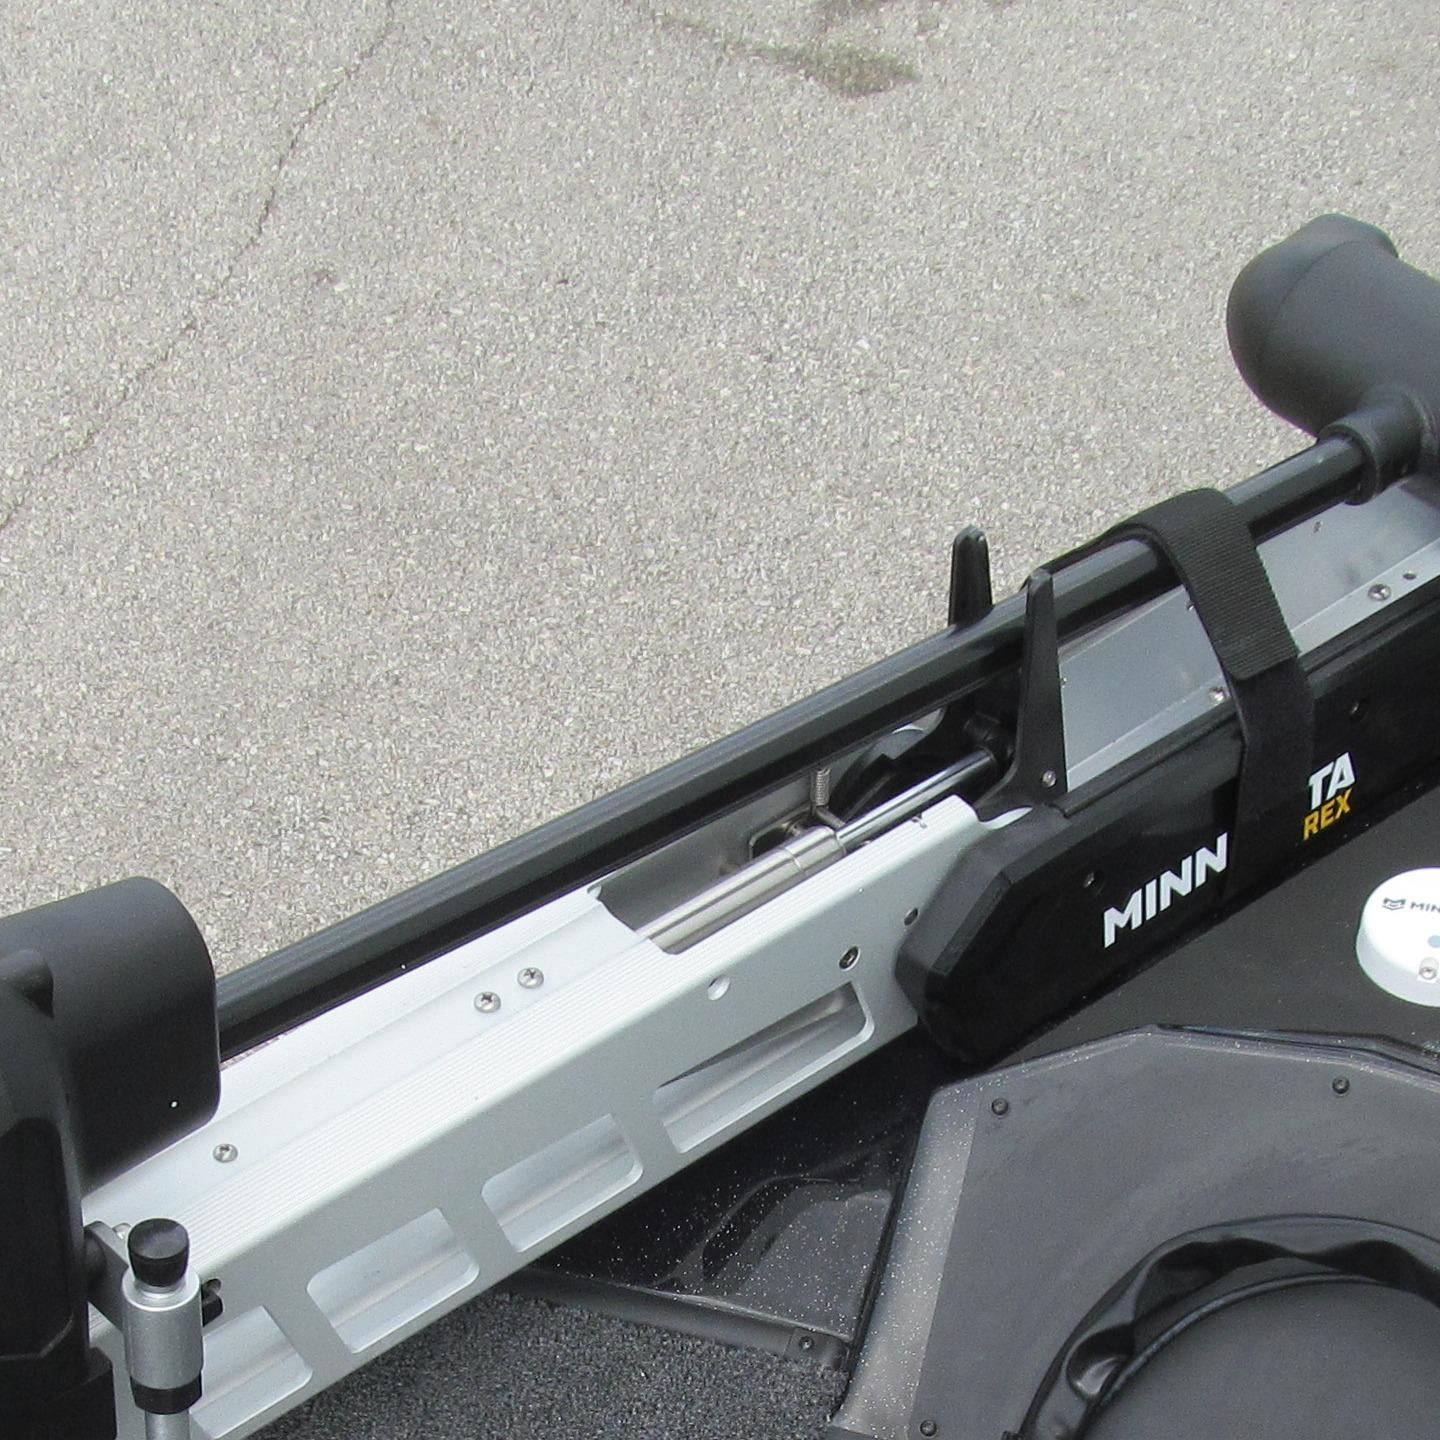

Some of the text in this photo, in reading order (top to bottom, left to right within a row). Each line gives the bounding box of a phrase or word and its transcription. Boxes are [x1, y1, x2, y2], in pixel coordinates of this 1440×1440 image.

[1104, 752, 1355, 948] MINN TA
[1303, 789, 1352, 841] REX
